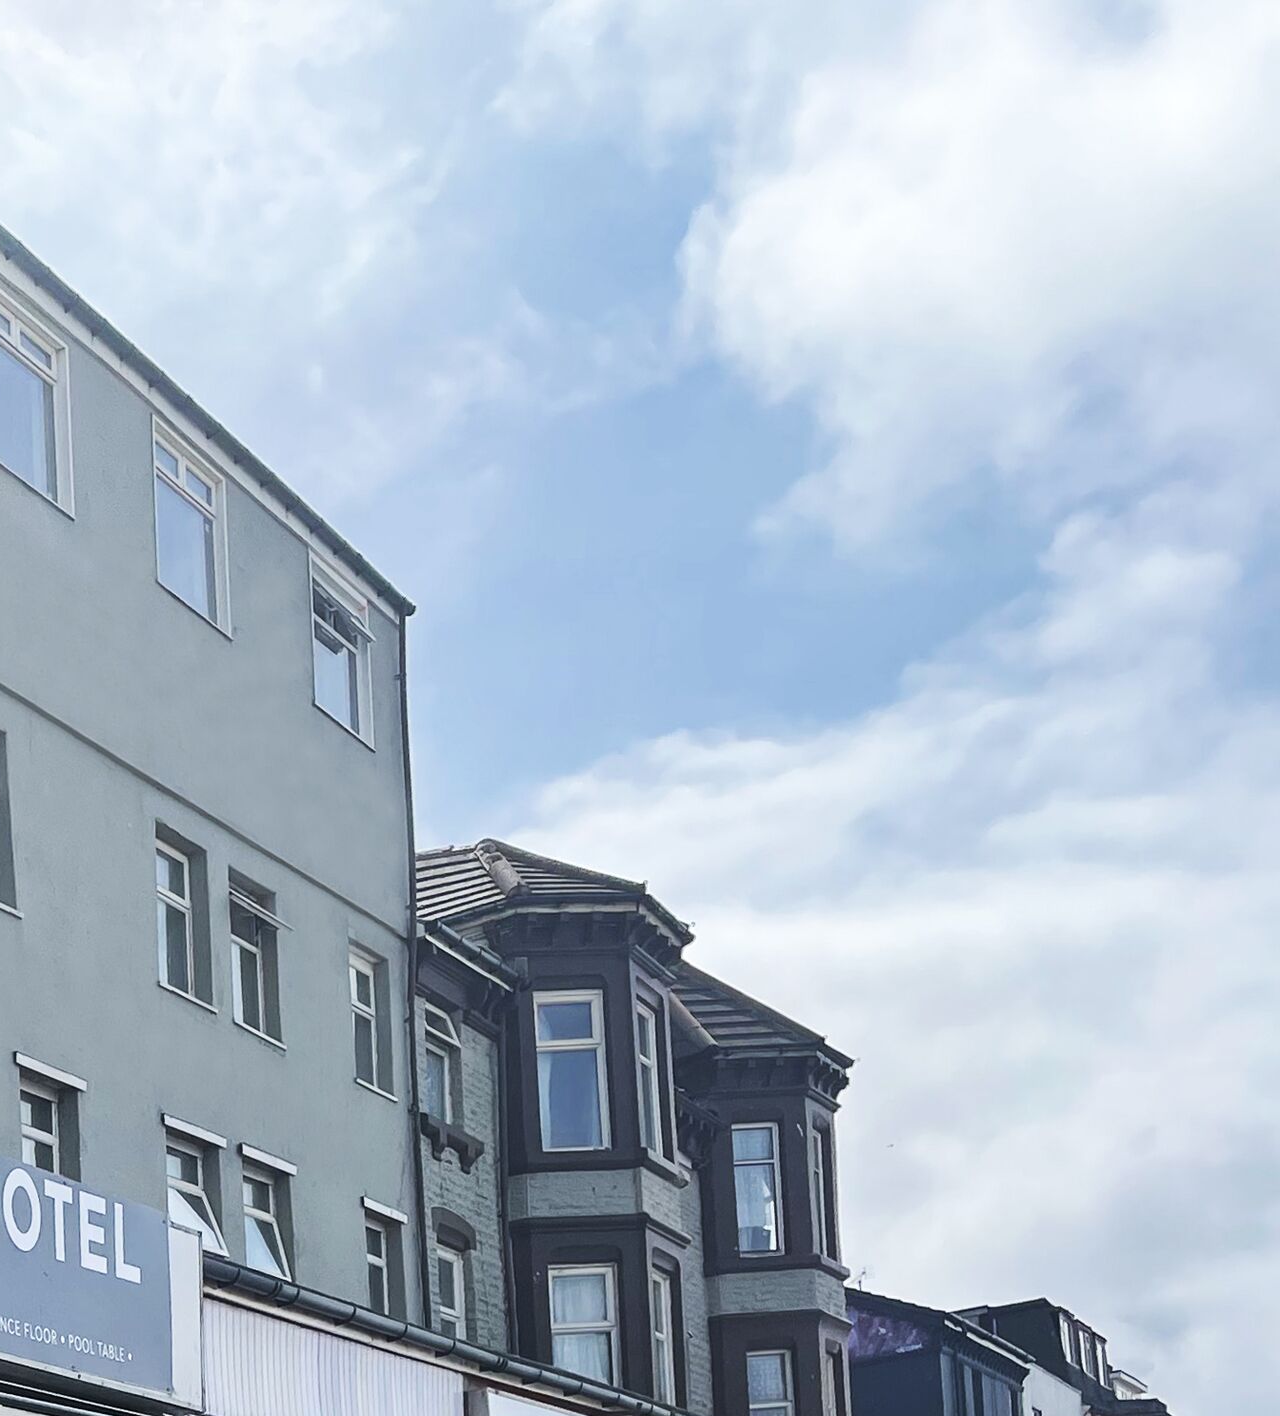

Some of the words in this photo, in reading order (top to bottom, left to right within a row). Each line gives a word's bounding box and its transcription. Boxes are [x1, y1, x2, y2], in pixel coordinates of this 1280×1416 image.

[24, 1324, 57, 1345] FLOOR
[68, 1334, 95, 1355] POOL
[96, 1342, 126, 1363] TABLE
